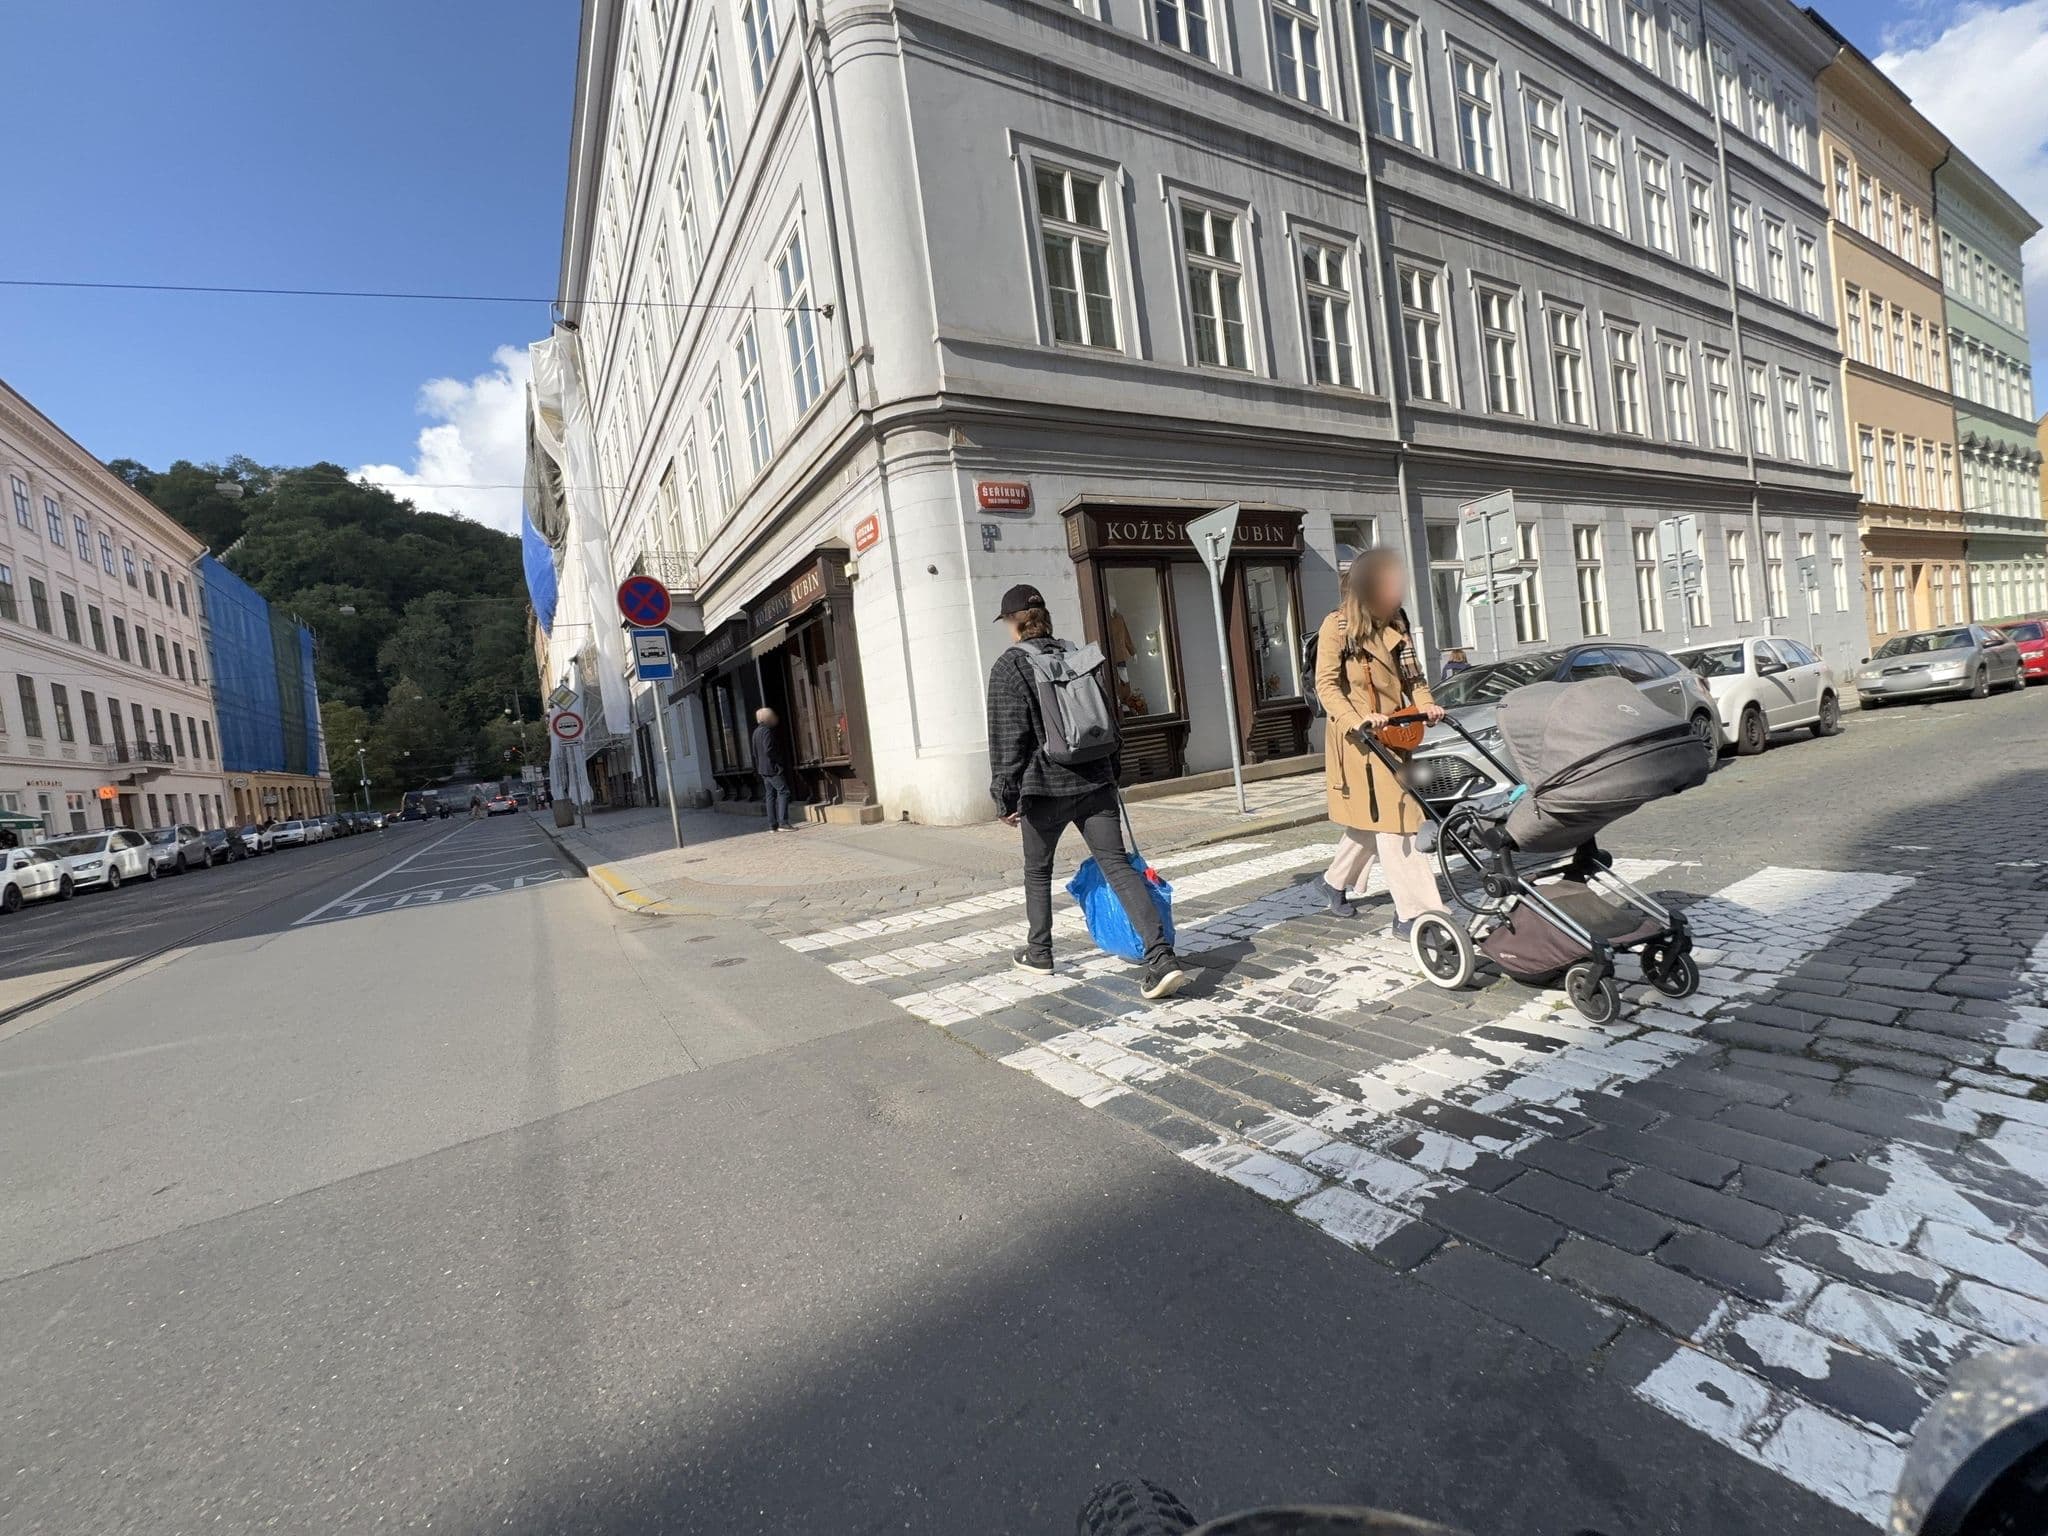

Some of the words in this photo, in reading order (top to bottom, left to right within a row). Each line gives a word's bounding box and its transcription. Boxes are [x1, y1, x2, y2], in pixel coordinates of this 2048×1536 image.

[982, 485, 1026, 498] ŠEŘÍKOVÁ
[1106, 521, 1191, 541] KOŽEŠI
[790, 571, 819, 604] KUBÍN
